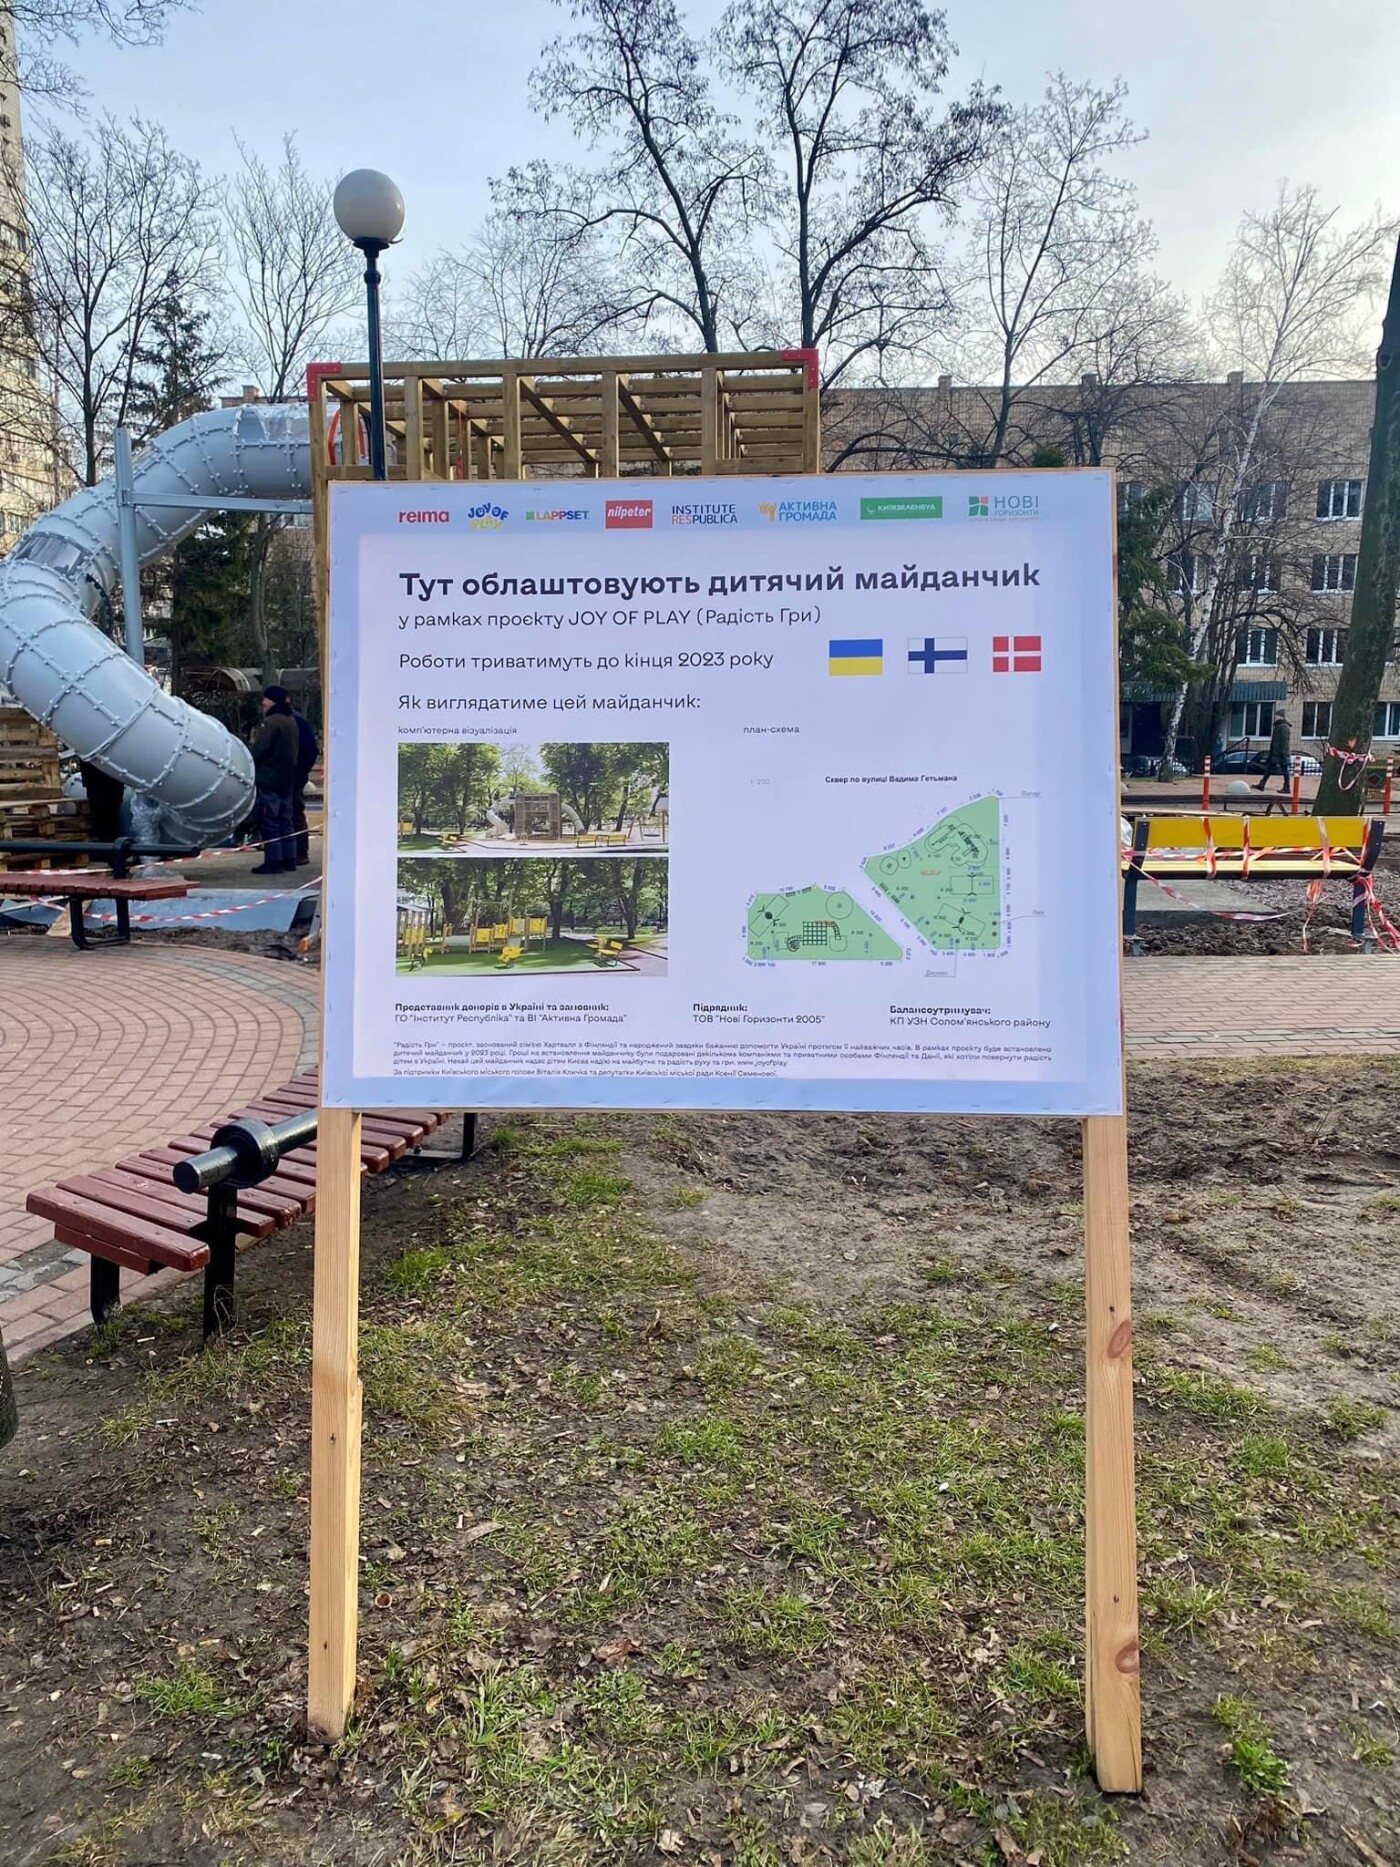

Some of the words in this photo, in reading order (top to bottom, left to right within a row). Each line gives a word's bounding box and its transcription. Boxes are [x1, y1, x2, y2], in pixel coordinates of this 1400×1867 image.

[778, 500, 838, 512] АКТИВНА
[994, 495, 1039, 509] НОВІ
[467, 502, 491, 519] JOY
[491, 504, 510, 521] OF
[607, 505, 651, 519] nilpeter
[671, 503, 736, 514] INSTITUTE
[398, 510, 450, 523] reima
[535, 510, 590, 520] LAPPSET
[671, 513, 738, 525] RESPUBLICA
[778, 511, 838, 523] ГРОМАДА
[398, 572, 454, 602] Тут
[462, 571, 700, 601] облаштовують
[708, 565, 844, 597] дитячий
[855, 562, 1041, 592] майданчик
[398, 615, 409, 630] у
[414, 611, 483, 630] рамках
[488, 611, 564, 630] проєкту
[568, 610, 608, 627] JOY
[612, 610, 639, 626] OF
[643, 609, 691, 625] PLAY
[696, 607, 774, 628] (Радість
[780, 605, 821, 626] Гри)
[399, 653, 466, 669] Роботи
[471, 656, 593, 672] триватимуть
[597, 656, 620, 670] до
[624, 652, 673, 670] кінця
[677, 651, 725, 667] 2023
[729, 650, 774, 670] року
[398, 694, 422, 710] Як
[426, 698, 548, 712] виглядатиме
[553, 694, 587, 712] цей
[592, 693, 701, 712] майданчик:
[398, 725, 460, 736] комп'ютерна
[462, 726, 518, 737] візуалізація
[743, 725, 800, 735] план-схема
[825, 775, 849, 785] Сквер
[849, 776, 861, 785] по
[861, 775, 888, 785] вулиці
[888, 775, 919, 784] Вадима
[920, 774, 958, 782] Гетьмана
[394, 1002, 460, 1013] Представник
[461, 1003, 500, 1013] донорів
[508, 1002, 545, 1013] Україні
[559, 1003, 609, 1012] замовник:
[692, 1003, 748, 1014] Підрядник:
[889, 1005, 991, 1017] Балансоутримувач:
[394, 1014, 408, 1023] ГО
[409, 1013, 455, 1024] "Інститут
[456, 1013, 513, 1025] Республіка"
[514, 1015, 526, 1023] та
[527, 1013, 537, 1023] ВІ
[538, 1013, 582, 1023] "Активна
[583, 1013, 628, 1024] Громада"
[692, 1014, 714, 1024] ТОВ
[715, 1014, 741, 1023] "Нові
[742, 1014, 794, 1025] Горизонти
[795, 1014, 826, 1024] 2005"
[889, 1016, 905, 1026] КП
[906, 1016, 928, 1026] УЗН
[929, 1016, 1012, 1027] Солом'янського
[1013, 1017, 1051, 1029] району
